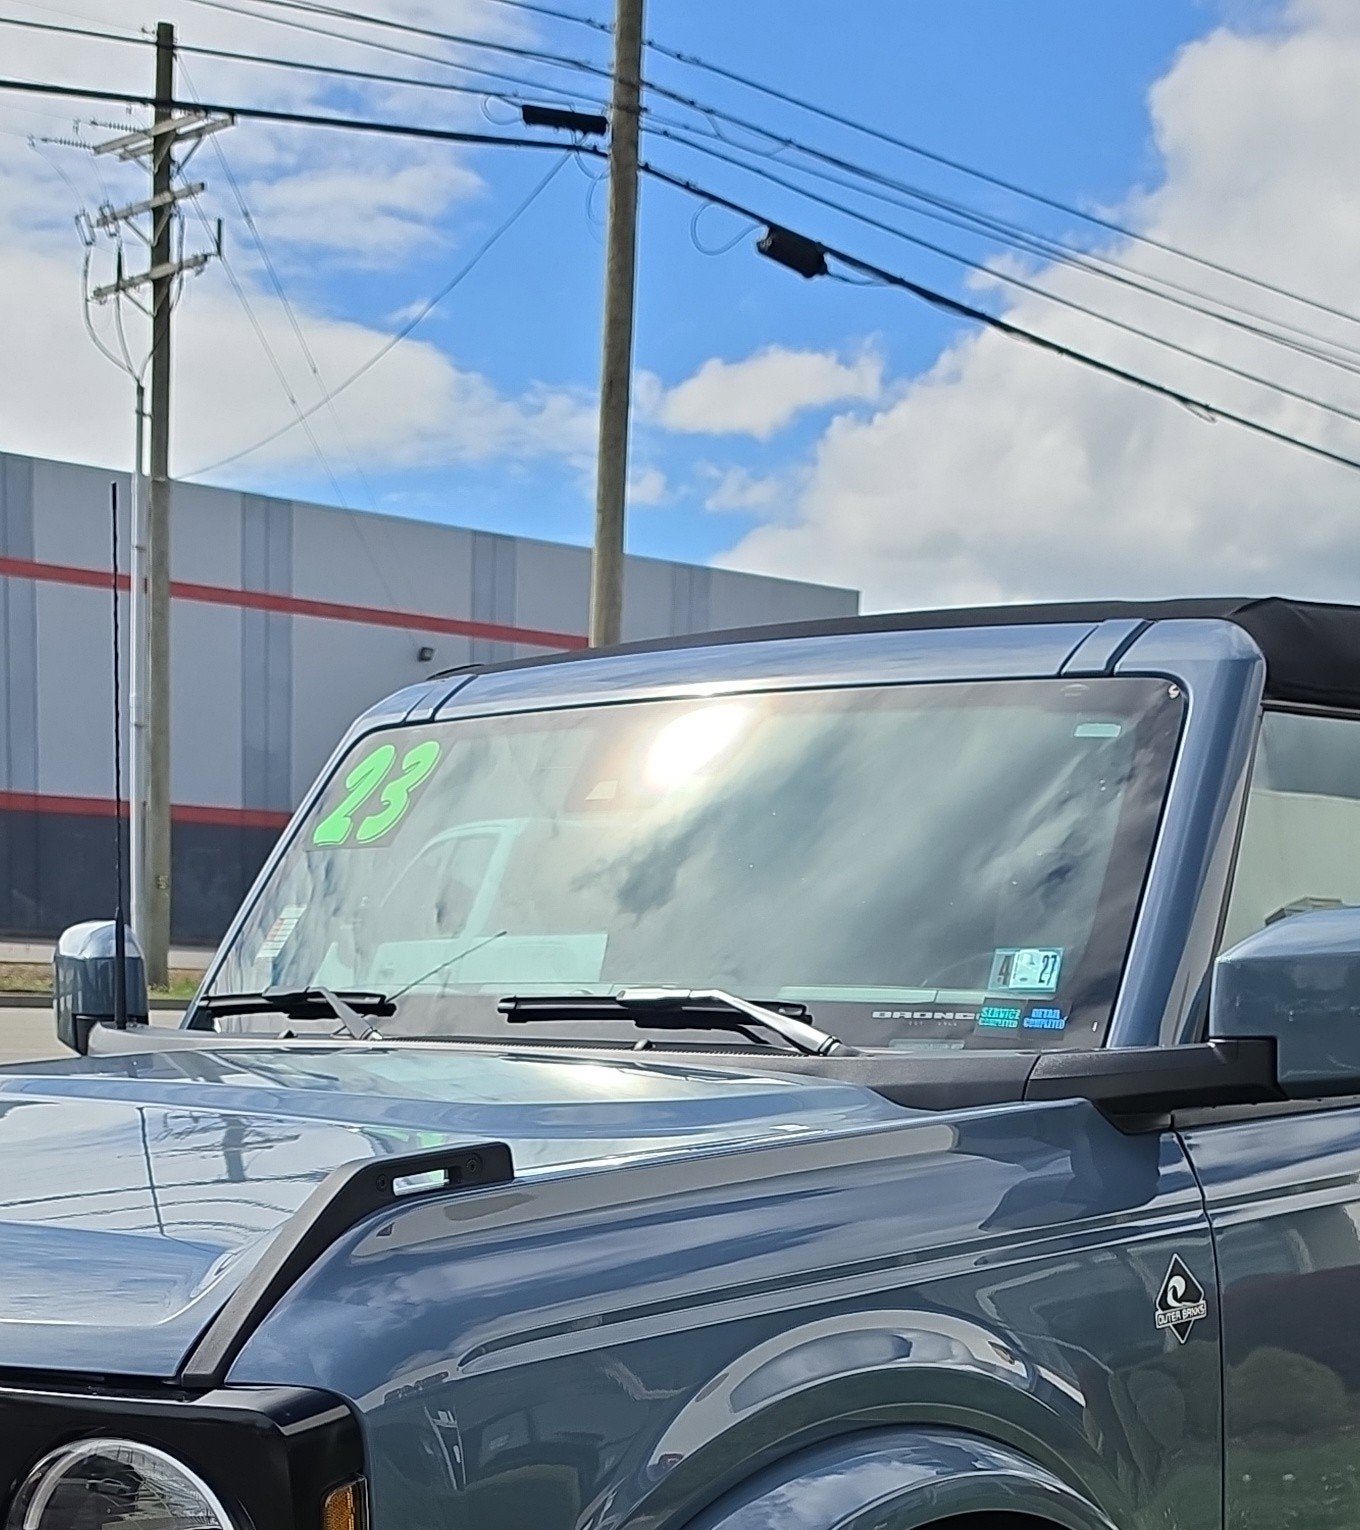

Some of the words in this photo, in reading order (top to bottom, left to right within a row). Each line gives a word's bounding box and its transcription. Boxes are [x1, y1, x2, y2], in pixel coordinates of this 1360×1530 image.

[313, 741, 442, 846] 23
[1038, 955, 1058, 985] 27
[1158, 1311, 1181, 1324] OUTER
